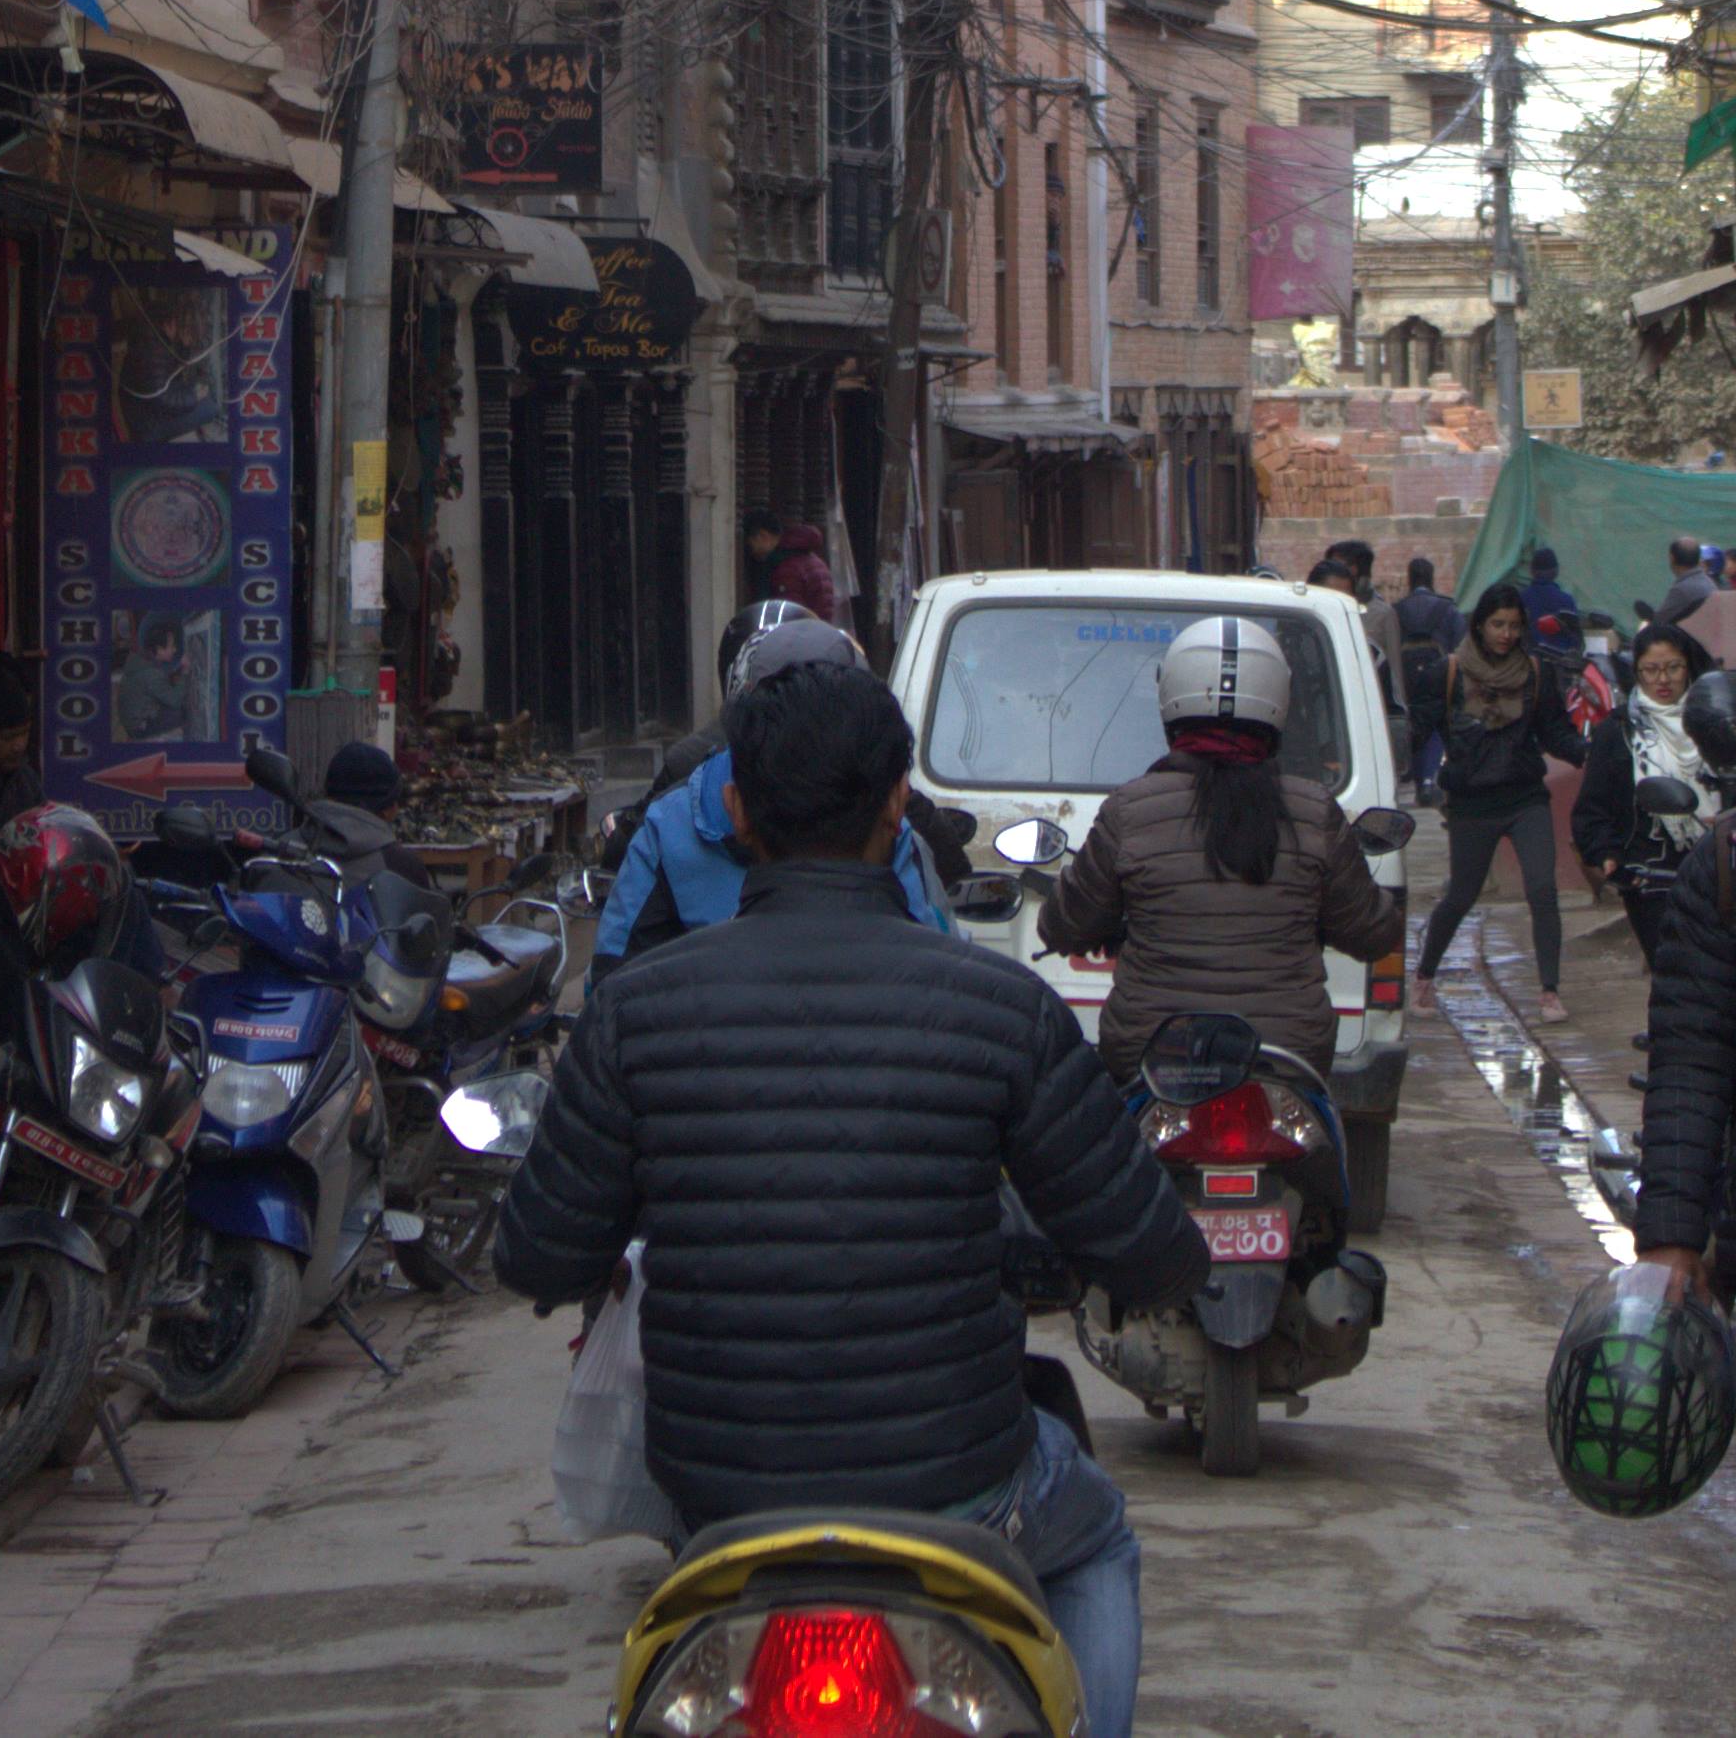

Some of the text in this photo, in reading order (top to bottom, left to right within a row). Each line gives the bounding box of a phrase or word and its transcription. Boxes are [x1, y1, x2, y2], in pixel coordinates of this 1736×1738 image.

[591, 247, 655, 278] offee
[598, 279, 647, 309] Tea
[582, 335, 631, 361] Tapas
[635, 337, 672, 359] Bar
[55, 277, 99, 758] THANKA SCHOOL
[239, 277, 281, 756] THANKA SCHOOL
[1076, 625, 1180, 644] CHELSE
[1205, 1229, 1284, 1256] ८७०
